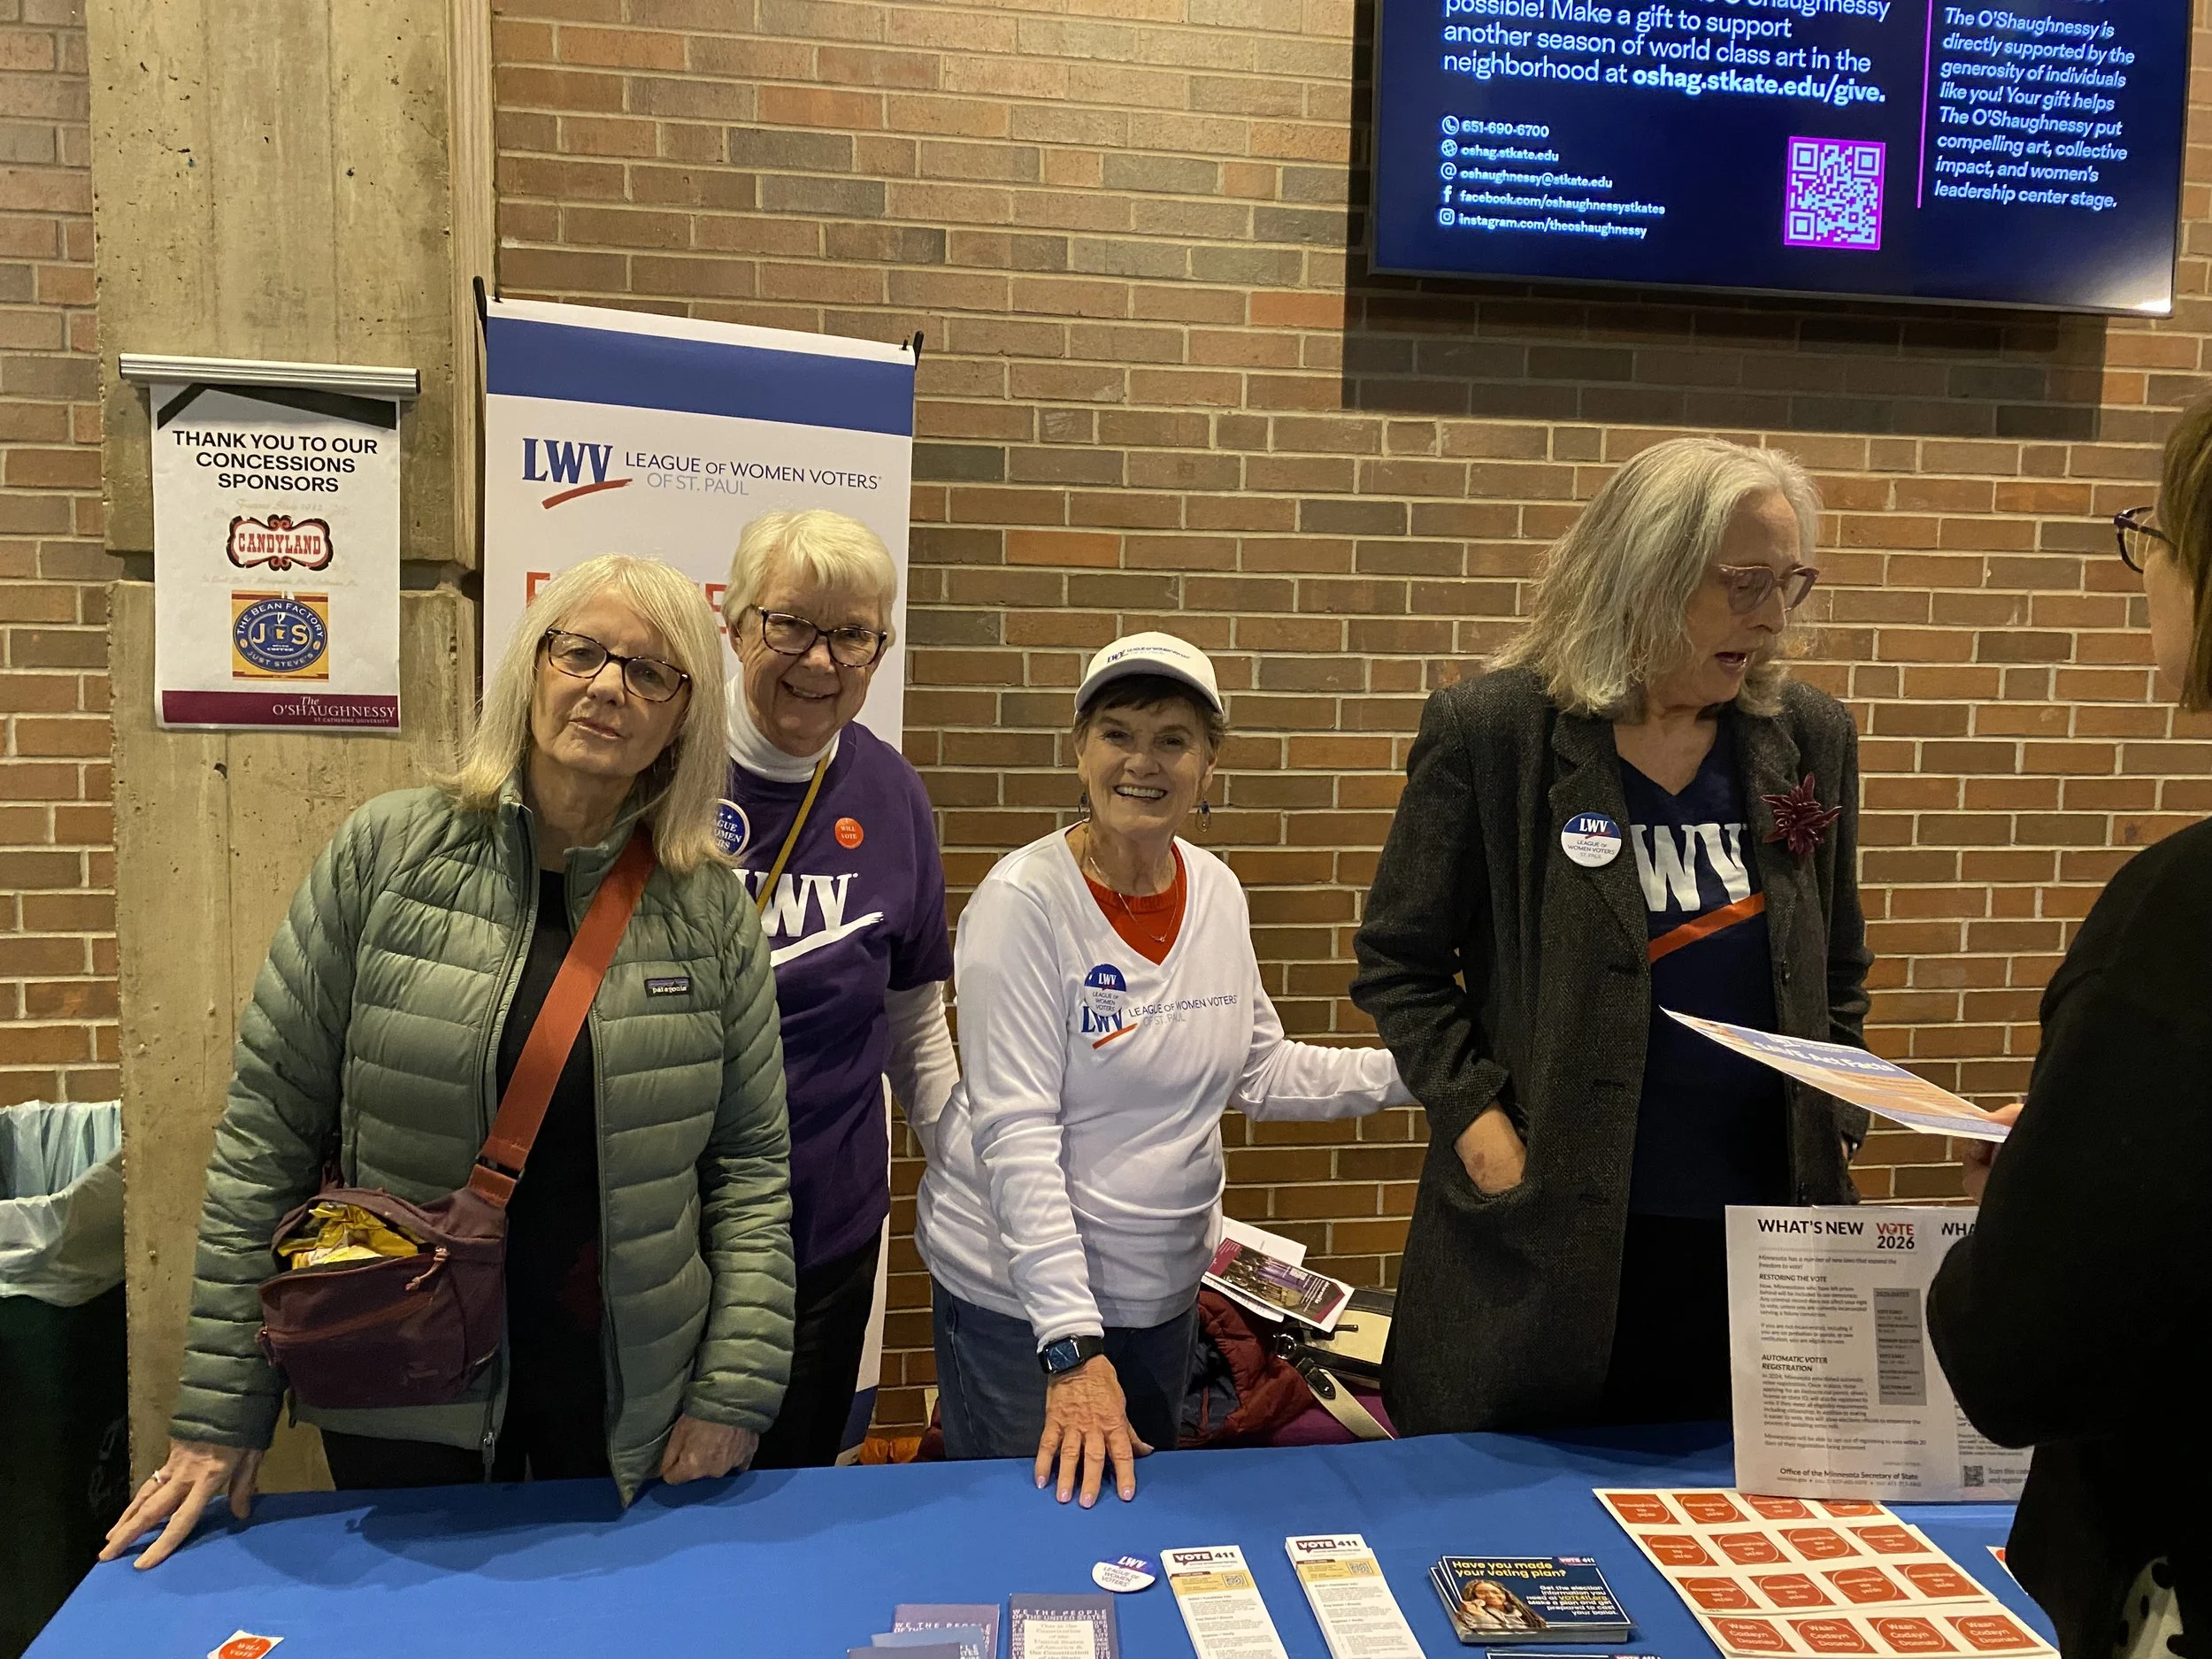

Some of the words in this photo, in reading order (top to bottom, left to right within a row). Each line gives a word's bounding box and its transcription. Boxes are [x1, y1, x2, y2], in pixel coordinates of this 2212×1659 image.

[1445, 0, 1545, 19] possible!
[1551, 0, 1612, 24] Make
[1617, 9, 1631, 25] a
[1635, 4, 1673, 34] gift
[1678, 10, 1701, 30] to
[1706, 15, 1793, 41] support
[1946, 7, 1975, 26] The
[1978, 10, 2101, 41] O'Shaughnessy
[2101, 20, 2116, 38] is
[1444, 21, 1532, 47] another
[1537, 33, 1616, 54] season
[1621, 34, 1645, 56] of
[1648, 37, 1710, 61] world
[1717, 40, 1770, 65] class
[1776, 47, 1807, 68] art
[1811, 46, 1831, 70] in
[1836, 49, 1872, 73] the
[1943, 33, 2003, 57] directly
[2004, 42, 2086, 60] supported
[2087, 43, 2108, 65] by
[2109, 47, 2135, 65] the
[1443, 50, 1600, 81] neighborhood
[1605, 64, 1628, 84] at
[1632, 65, 1886, 106] oshag.stkate.edu/give.
[1940, 60, 2025, 83] generosity
[2026, 65, 2045, 81] of
[2046, 65, 2127, 87] individuals
[1939, 81, 1968, 99] like
[1969, 86, 2004, 105] you!
[2006, 87, 2041, 105] Your
[2042, 91, 2071, 111] gift
[2074, 93, 2116, 113] helps
[1462, 120, 1550, 137] 651-690-6700
[1939, 105, 1970, 124] The
[1972, 108, 2093, 137] O'Shaughnessy
[2094, 120, 2124, 139] put
[1461, 144, 1560, 162] oshag.stkate.edu
[1937, 134, 2024, 157] compelling
[2026, 141, 2052, 157] art,
[2055, 141, 2128, 160] collective
[1460, 167, 1613, 188] oshaughnessy@stkate.edu
[1935, 155, 1994, 178] impact,
[1997, 161, 2029, 178] and
[2031, 165, 2099, 182] women's
[1460, 190, 1666, 215] facebook.com/oshaughnessystkates
[1933, 180, 2016, 205] leadership
[2018, 188, 2070, 204] center
[2070, 191, 2118, 211] stage.
[1458, 213, 1647, 239] instagram.com/theoshaughnessy
[173, 430, 247, 449] THANK
[250, 434, 295, 450] YOU
[298, 435, 326, 452] TO
[332, 437, 379, 454] OUR
[196, 452, 355, 473] CONCESSIONS
[522, 438, 613, 485] LWV
[626, 451, 701, 472] LEAGUE
[705, 462, 727, 475] OF
[730, 462, 804, 483] WOMEN
[218, 473, 339, 492] SPONSORS
[647, 472, 672, 488] OF
[676, 474, 700, 492] ST.
[704, 477, 749, 495] PAUL
[238, 533, 322, 555] CANDYLAND
[236, 614, 252, 635] THE
[250, 603, 282, 616] BEAN
[286, 603, 325, 638] FACTORY
[291, 624, 308, 645] S
[247, 651, 271, 666] JUST
[301, 695, 319, 705] The
[273, 704, 396, 718] O'SHAUGHNESSY
[1579, 818, 1609, 833] LWV
[1630, 823, 1750, 912] WV
[1098, 972, 1117, 986] LWV
[1128, 1003, 1163, 1018] LEAGUE
[1164, 1002, 1175, 1012] OF
[1174, 999, 1207, 1010] WOMEN
[1207, 995, 1237, 1007] VOTERS
[1081, 1005, 1123, 1033] LWV
[1168, 1012, 1186, 1024] PAUL
[1757, 1218, 1823, 1234] WHAT'S
[1826, 1222, 1864, 1235] NEW
[1876, 1222, 1915, 1236] VOTE
[1877, 1235, 1915, 1249] 2026
[1762, 1354, 1805, 1363] AUTOMATIC
[1824, 1470, 1860, 1479] Minnesota
[1861, 1471, 1892, 1480] Secretary
[1298, 1540, 1334, 1549] VOTE
[1102, 1566, 1131, 1576] LEAGUE
[1118, 1556, 1147, 1569] LWV
[1486, 1562, 1512, 1571] you
[1102, 1576, 1128, 1587] VOTERS
[1104, 1572, 1132, 1583] WOMEN
[1455, 1569, 1486, 1578] your
[1487, 1569, 1530, 1578] voting
[1531, 1569, 1566, 1578] plan?
[1727, 1622, 1757, 1631] Waan
[1729, 1630, 1768, 1639] Codayn
[1969, 1629, 2010, 1638] Codayn
